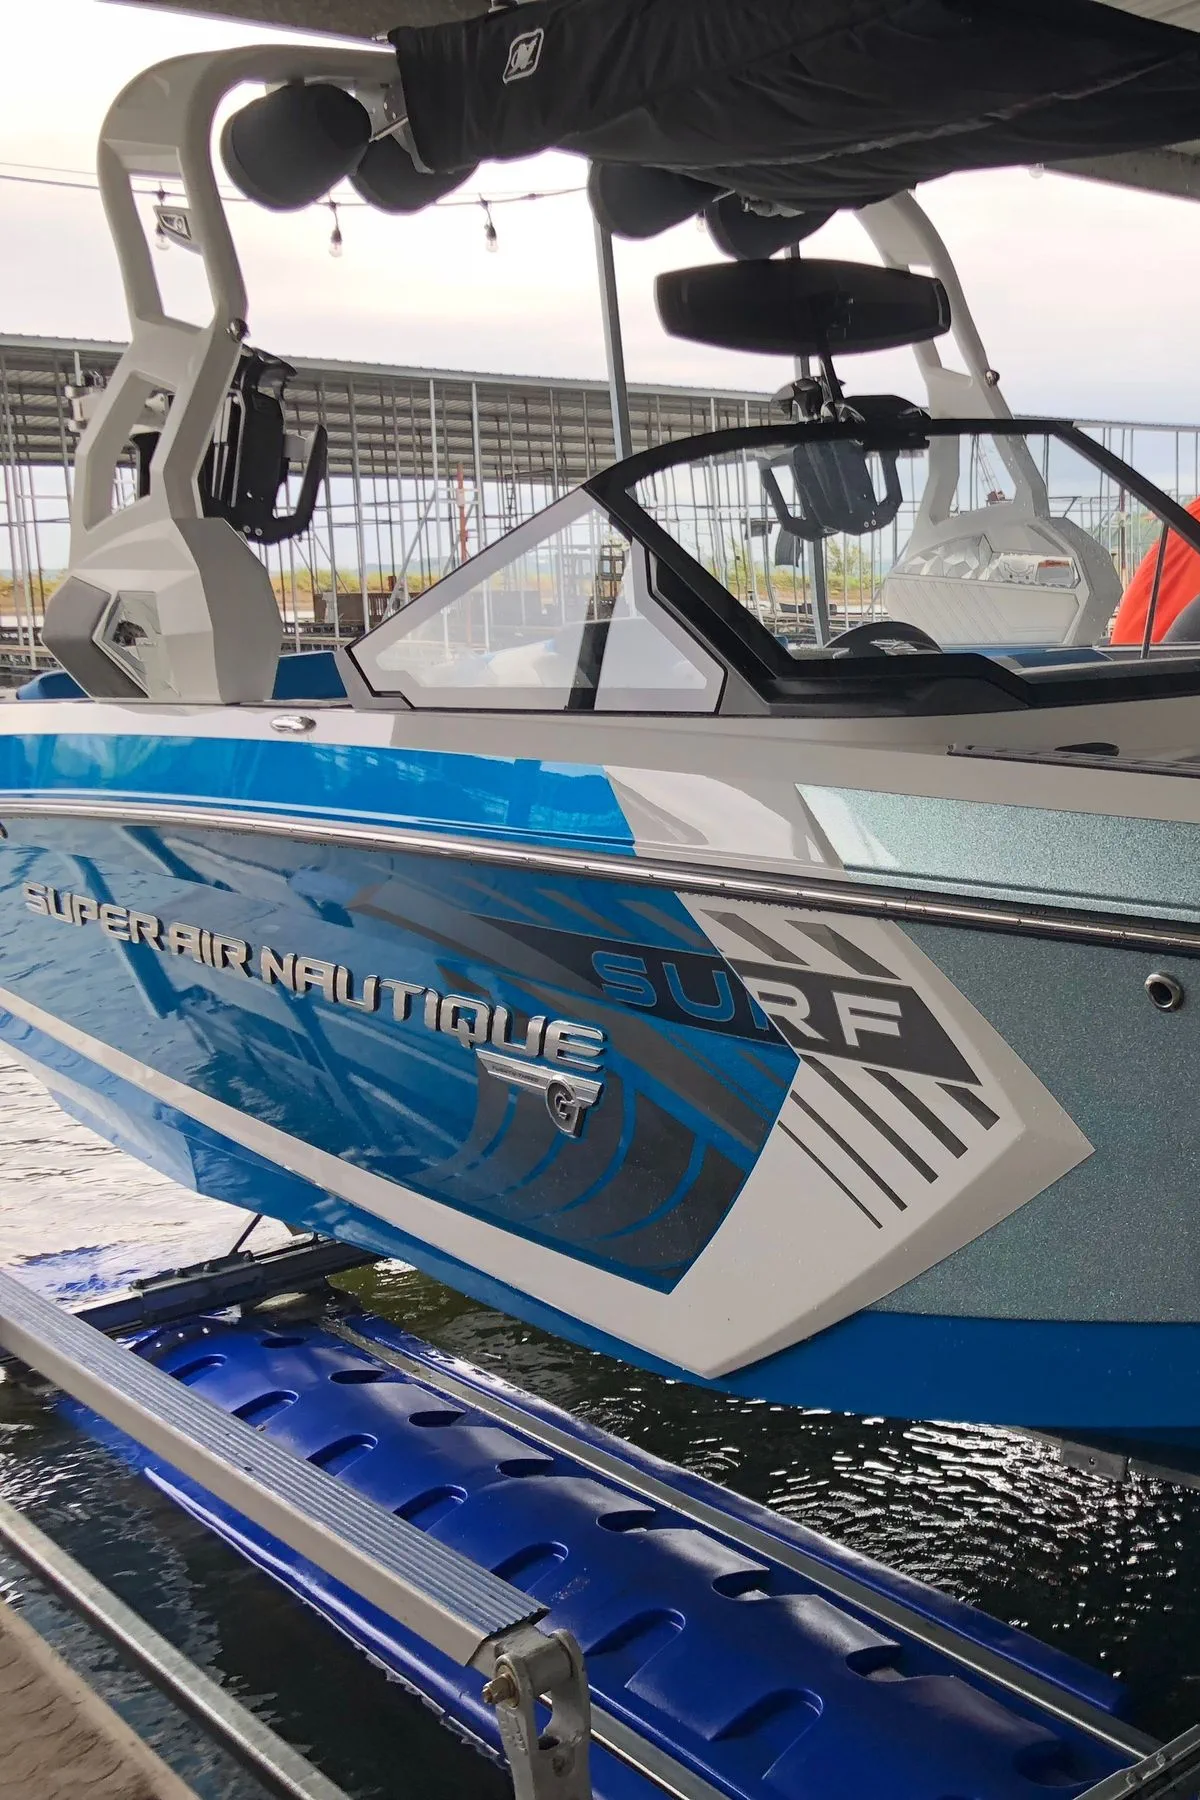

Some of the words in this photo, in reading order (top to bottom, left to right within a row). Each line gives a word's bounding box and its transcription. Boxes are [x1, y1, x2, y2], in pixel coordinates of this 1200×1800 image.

[23, 880, 164, 951] SUPER
[168, 921, 253, 978] AIR
[260, 945, 604, 1072] NAUTIQUE
[591, 950, 903, 1048] SURF
